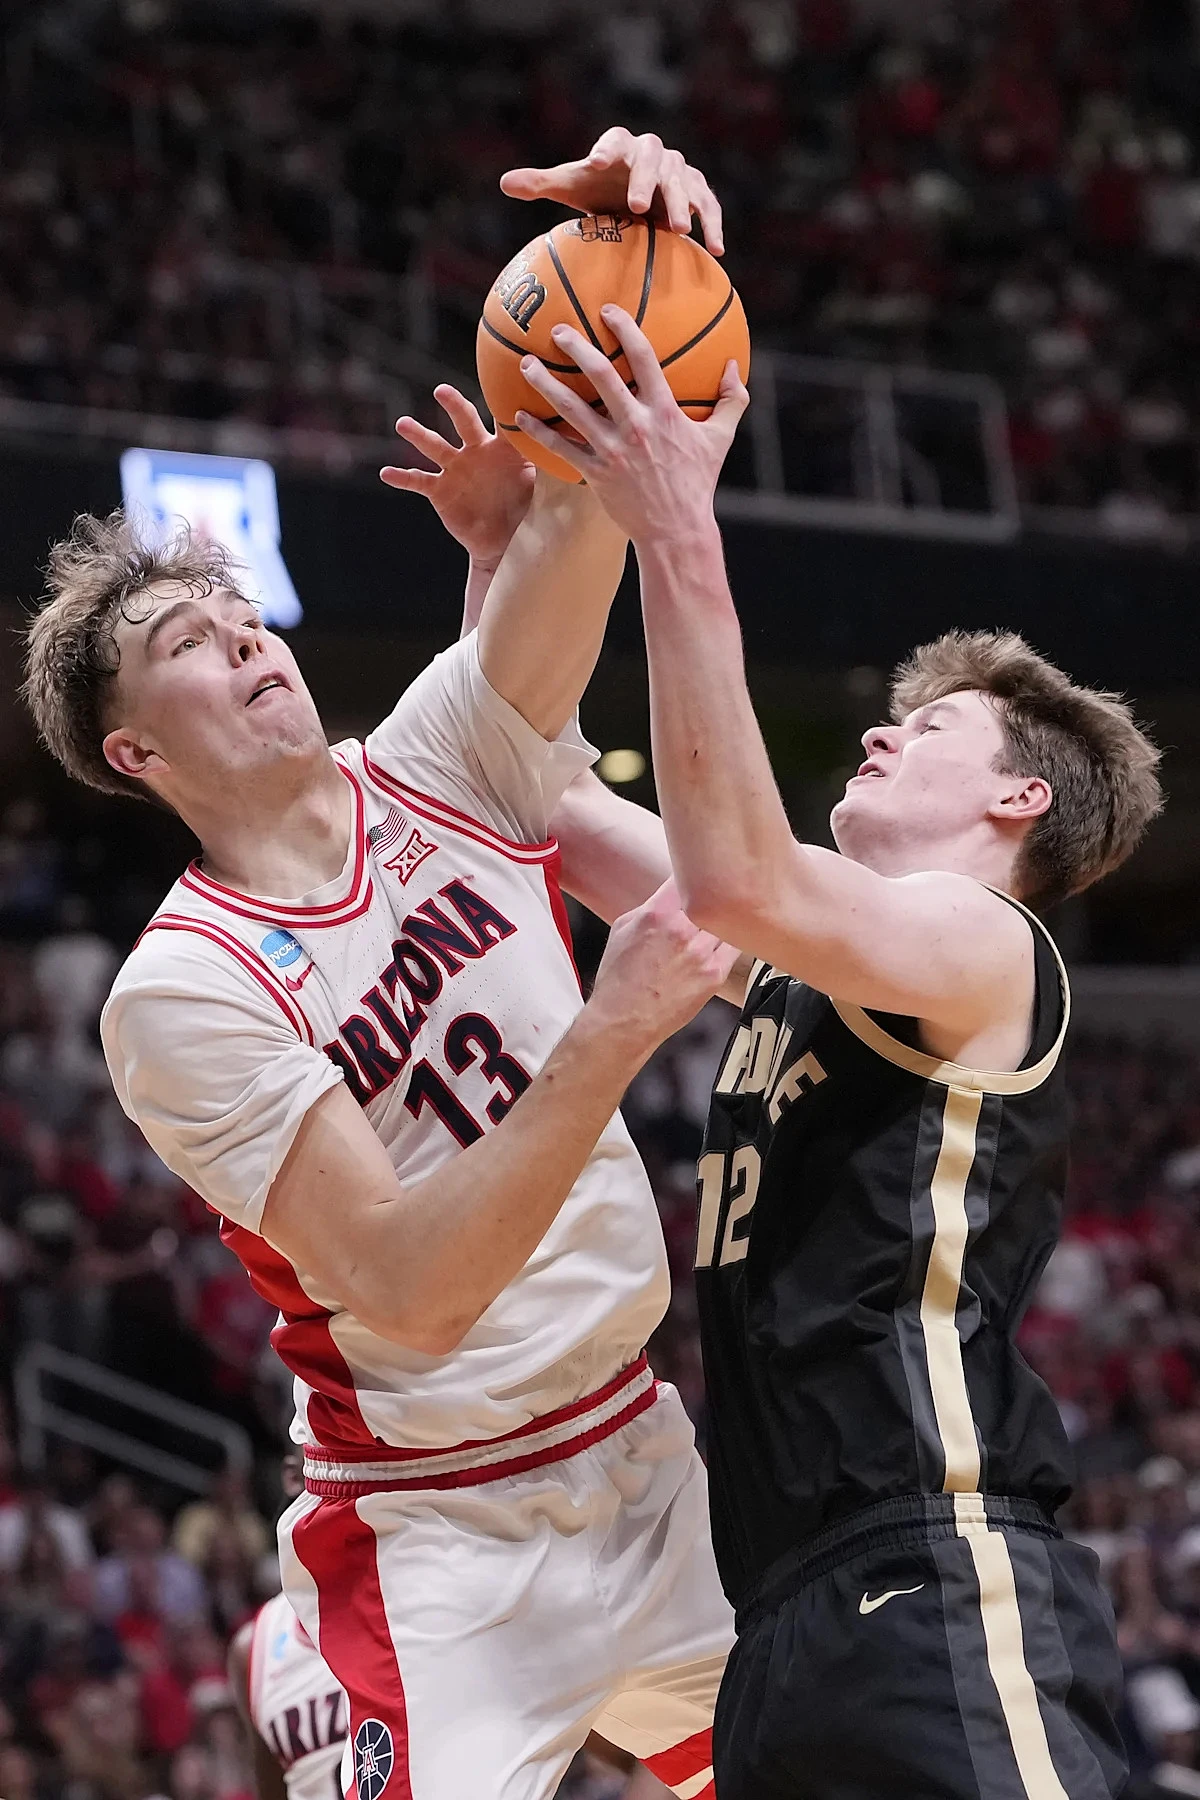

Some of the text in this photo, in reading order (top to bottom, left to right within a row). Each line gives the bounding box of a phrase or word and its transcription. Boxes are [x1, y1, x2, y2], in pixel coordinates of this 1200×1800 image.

[383, 828, 439, 887] XII
[322, 878, 518, 1108] ARIZONA
[403, 1012, 533, 1150] 13
[693, 1144, 762, 1270] 12
